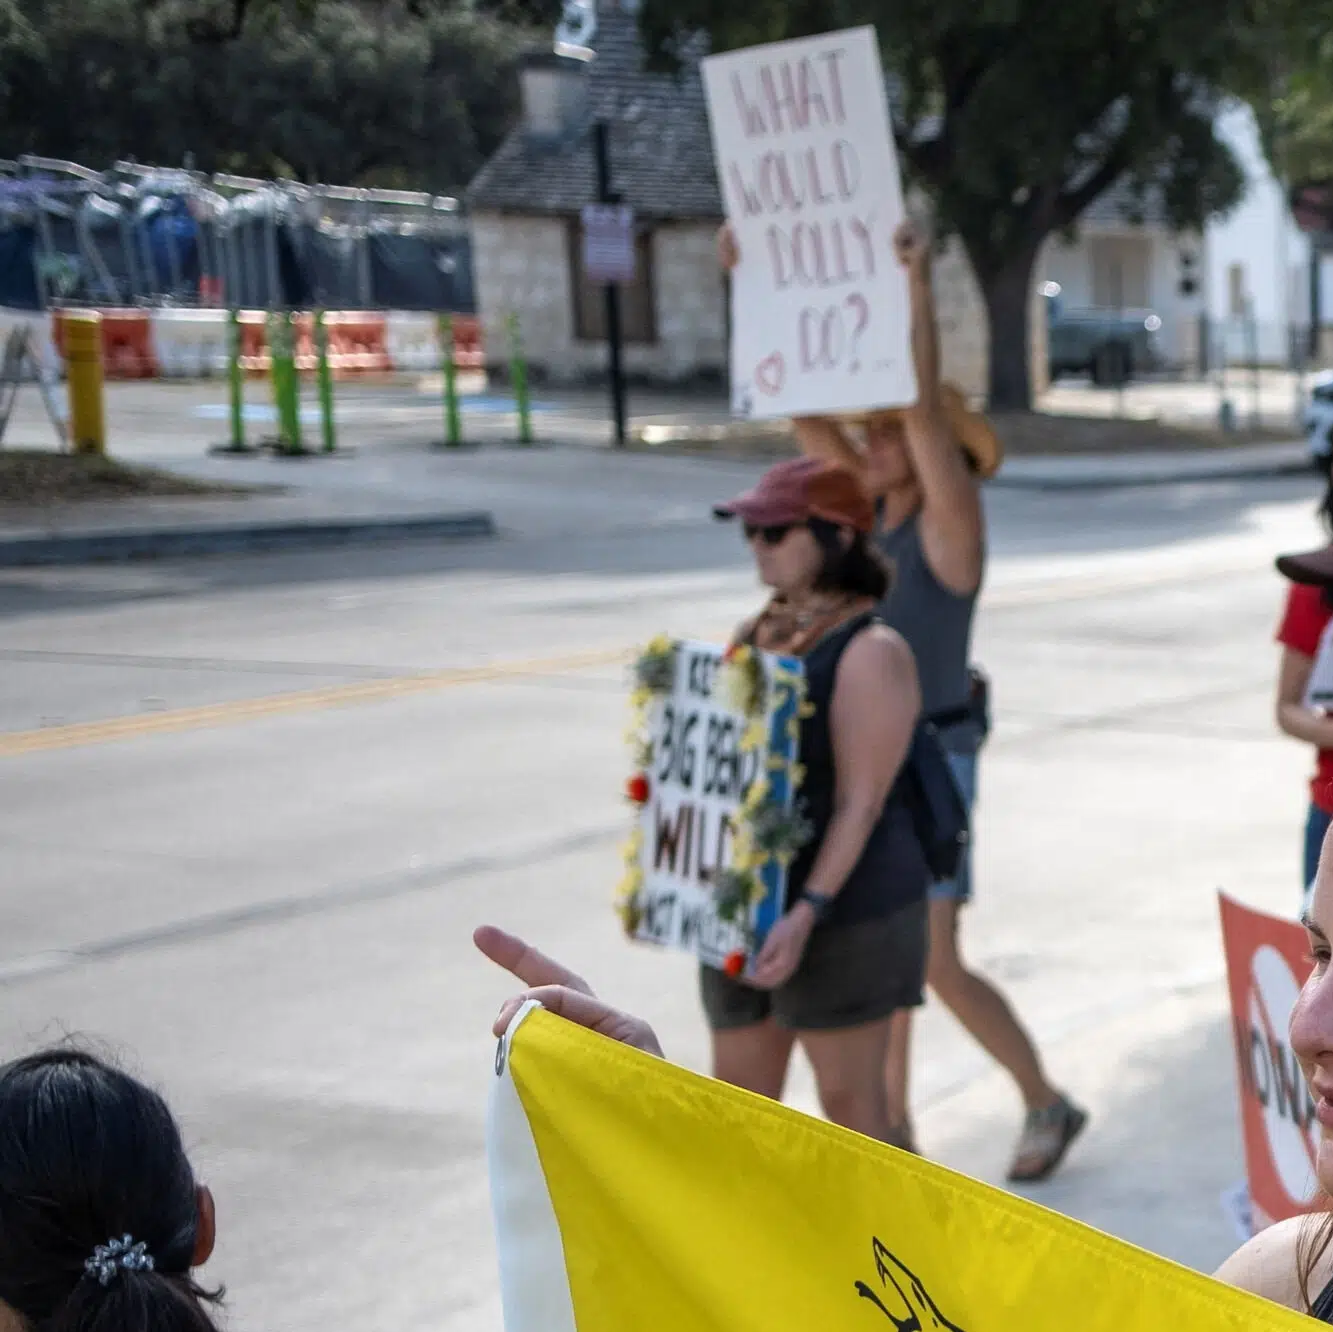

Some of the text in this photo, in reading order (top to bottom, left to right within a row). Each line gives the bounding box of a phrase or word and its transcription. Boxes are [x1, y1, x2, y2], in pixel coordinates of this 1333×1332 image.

[731, 48, 848, 138] WHAT
[729, 139, 861, 217] WOULD
[765, 213, 878, 291] DOLLY
[798, 293, 869, 374] DO?
